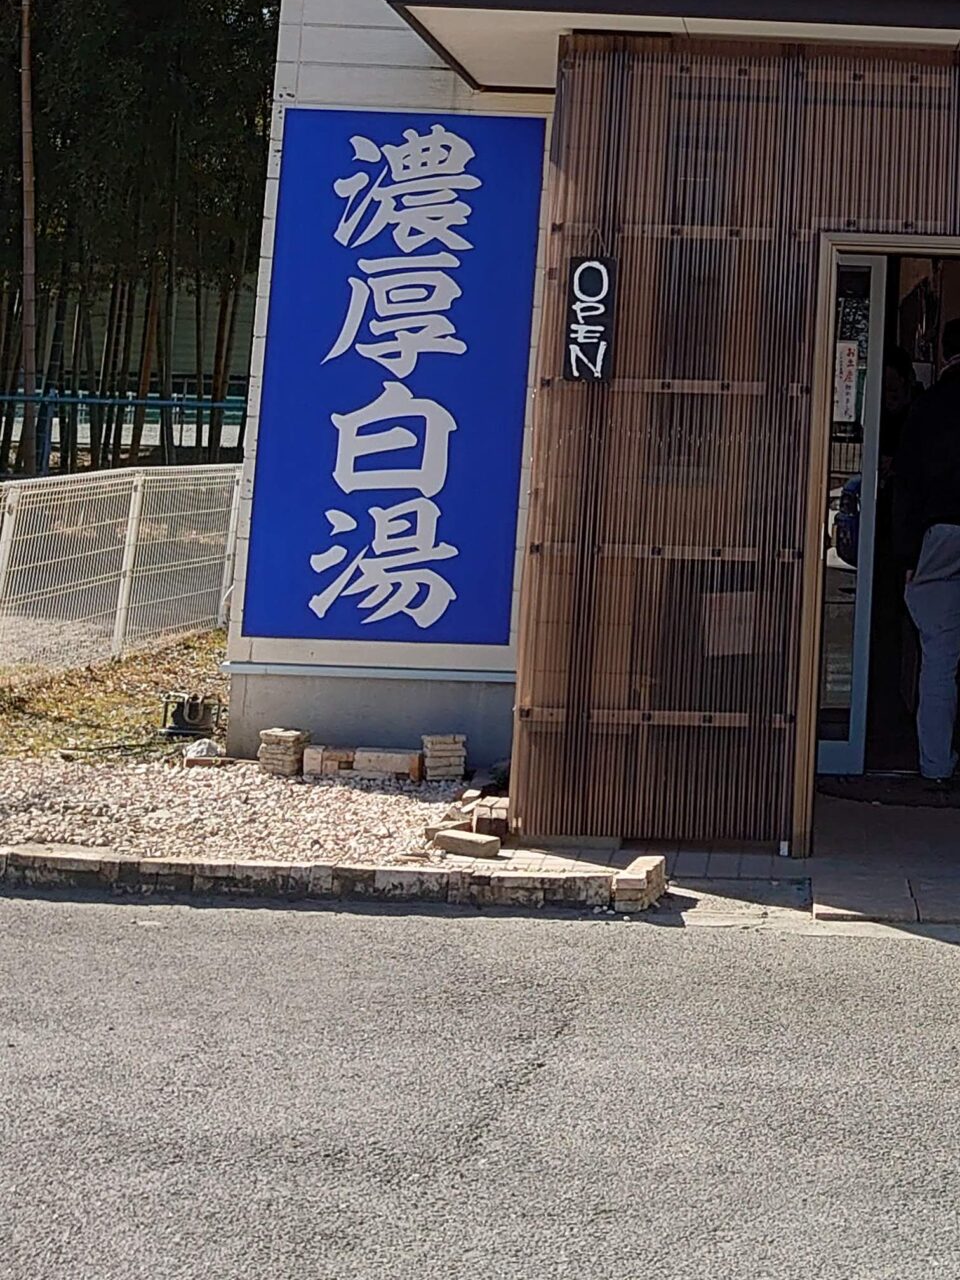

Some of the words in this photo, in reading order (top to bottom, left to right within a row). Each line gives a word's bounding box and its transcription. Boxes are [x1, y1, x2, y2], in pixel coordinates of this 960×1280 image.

[309, 123, 482, 629] 濃厚白湯
[569, 260, 609, 379] OPEN
